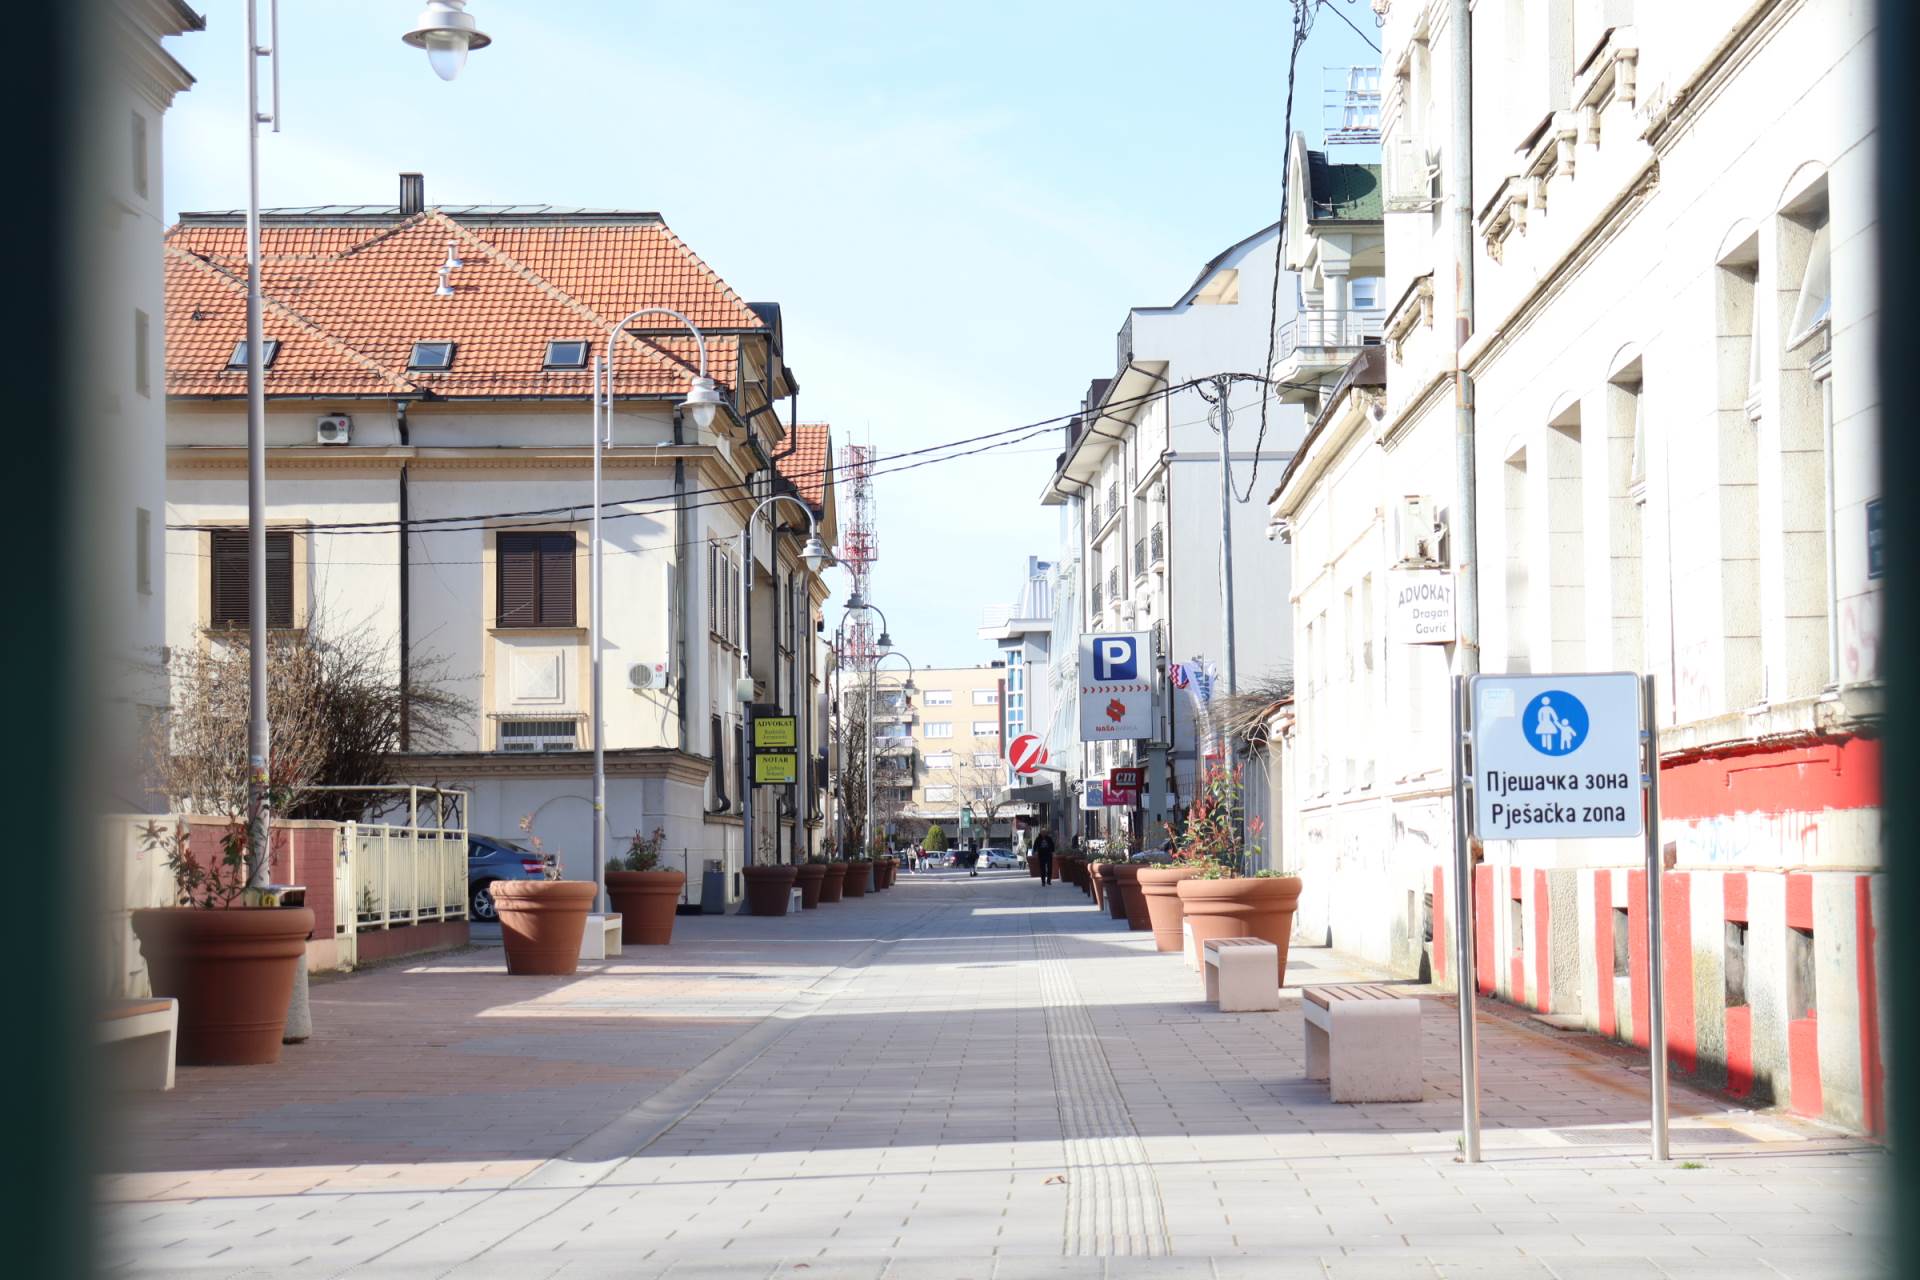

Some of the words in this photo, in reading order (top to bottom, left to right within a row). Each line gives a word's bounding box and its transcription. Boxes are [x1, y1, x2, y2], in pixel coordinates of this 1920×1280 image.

[1398, 584, 1450, 608] ADVOKAT
[1413, 608, 1449, 620] Dragan
[1101, 640, 1131, 679] P
[757, 720, 792, 728] ADVOKAT
[1487, 771, 1579, 797] Пјешачка
[1585, 773, 1628, 790] зона
[1491, 803, 1576, 829] Pješačka
[1583, 806, 1626, 822] zona
